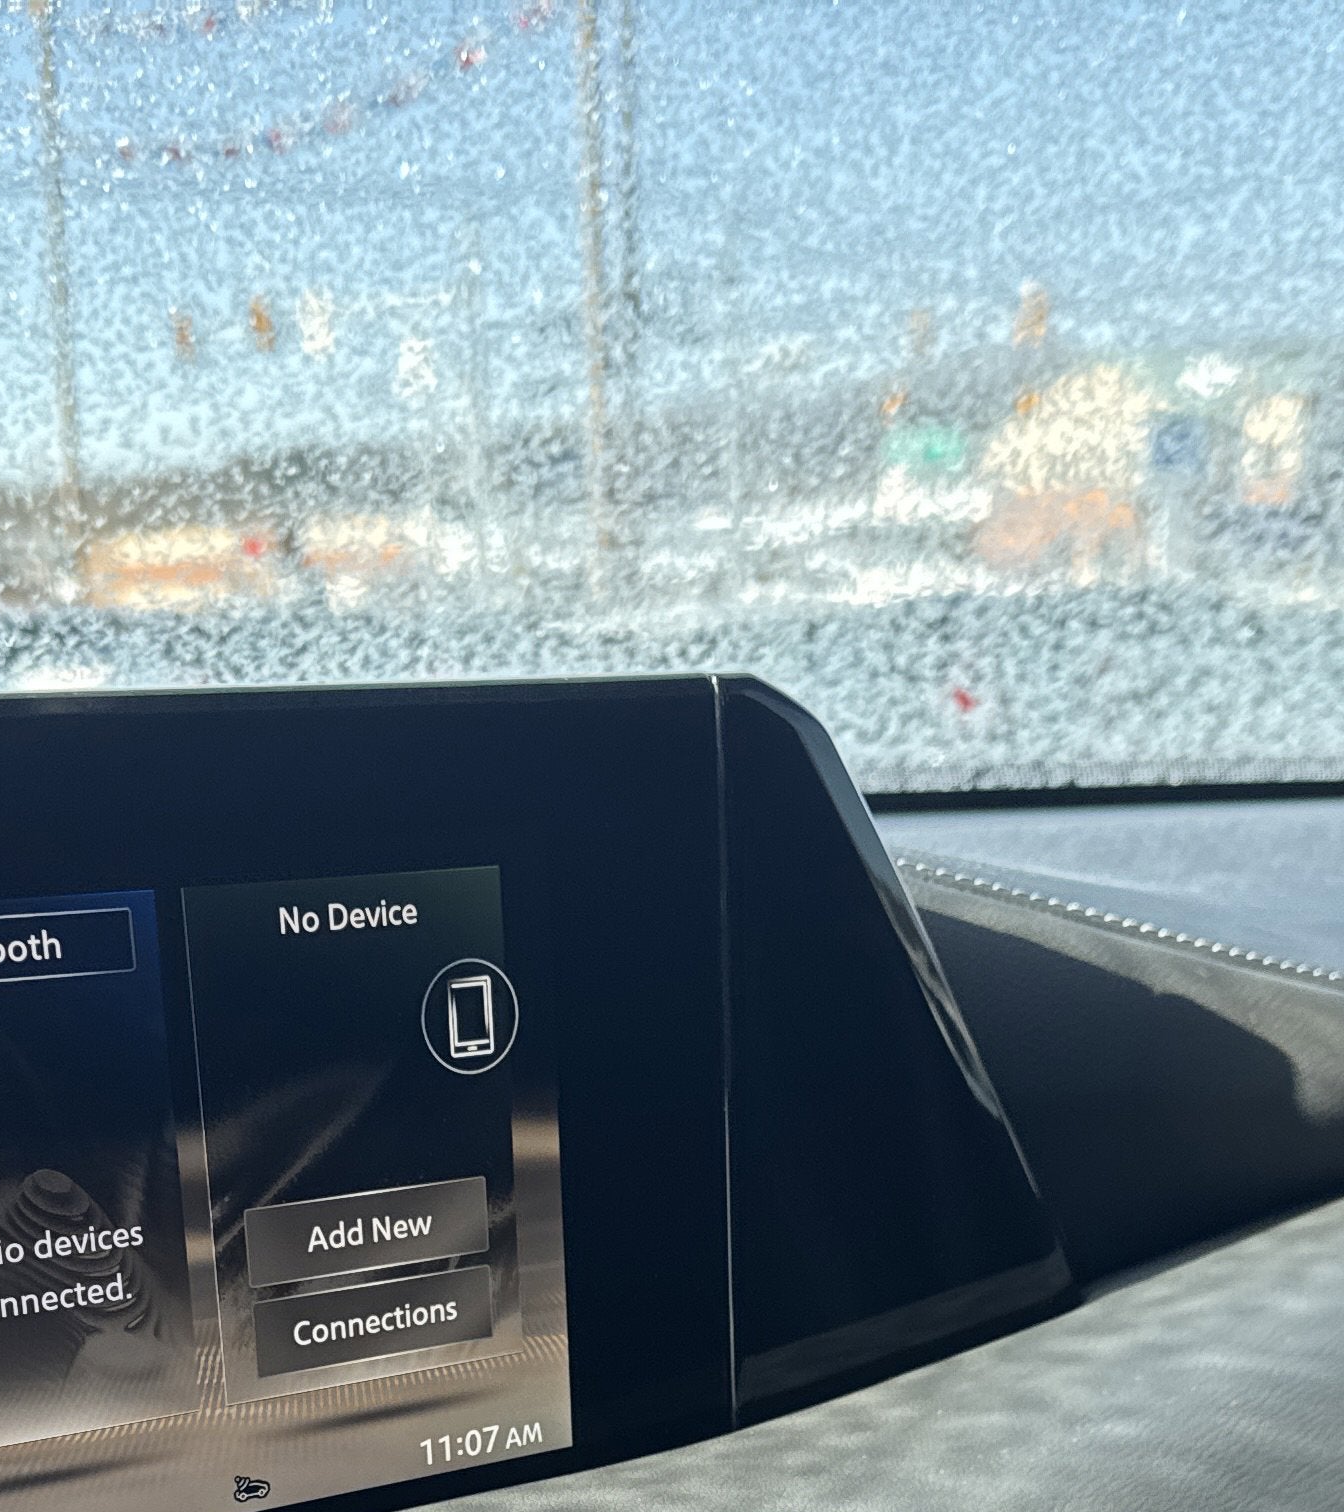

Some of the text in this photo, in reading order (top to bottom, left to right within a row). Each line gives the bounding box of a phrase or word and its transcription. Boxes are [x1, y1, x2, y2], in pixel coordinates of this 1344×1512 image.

[278, 900, 418, 934] No Device
[34, 1224, 144, 1260] devices
[307, 1213, 432, 1253] Add New
[293, 1301, 458, 1346] Connections
[420, 1421, 543, 1467] 11:07 AM
